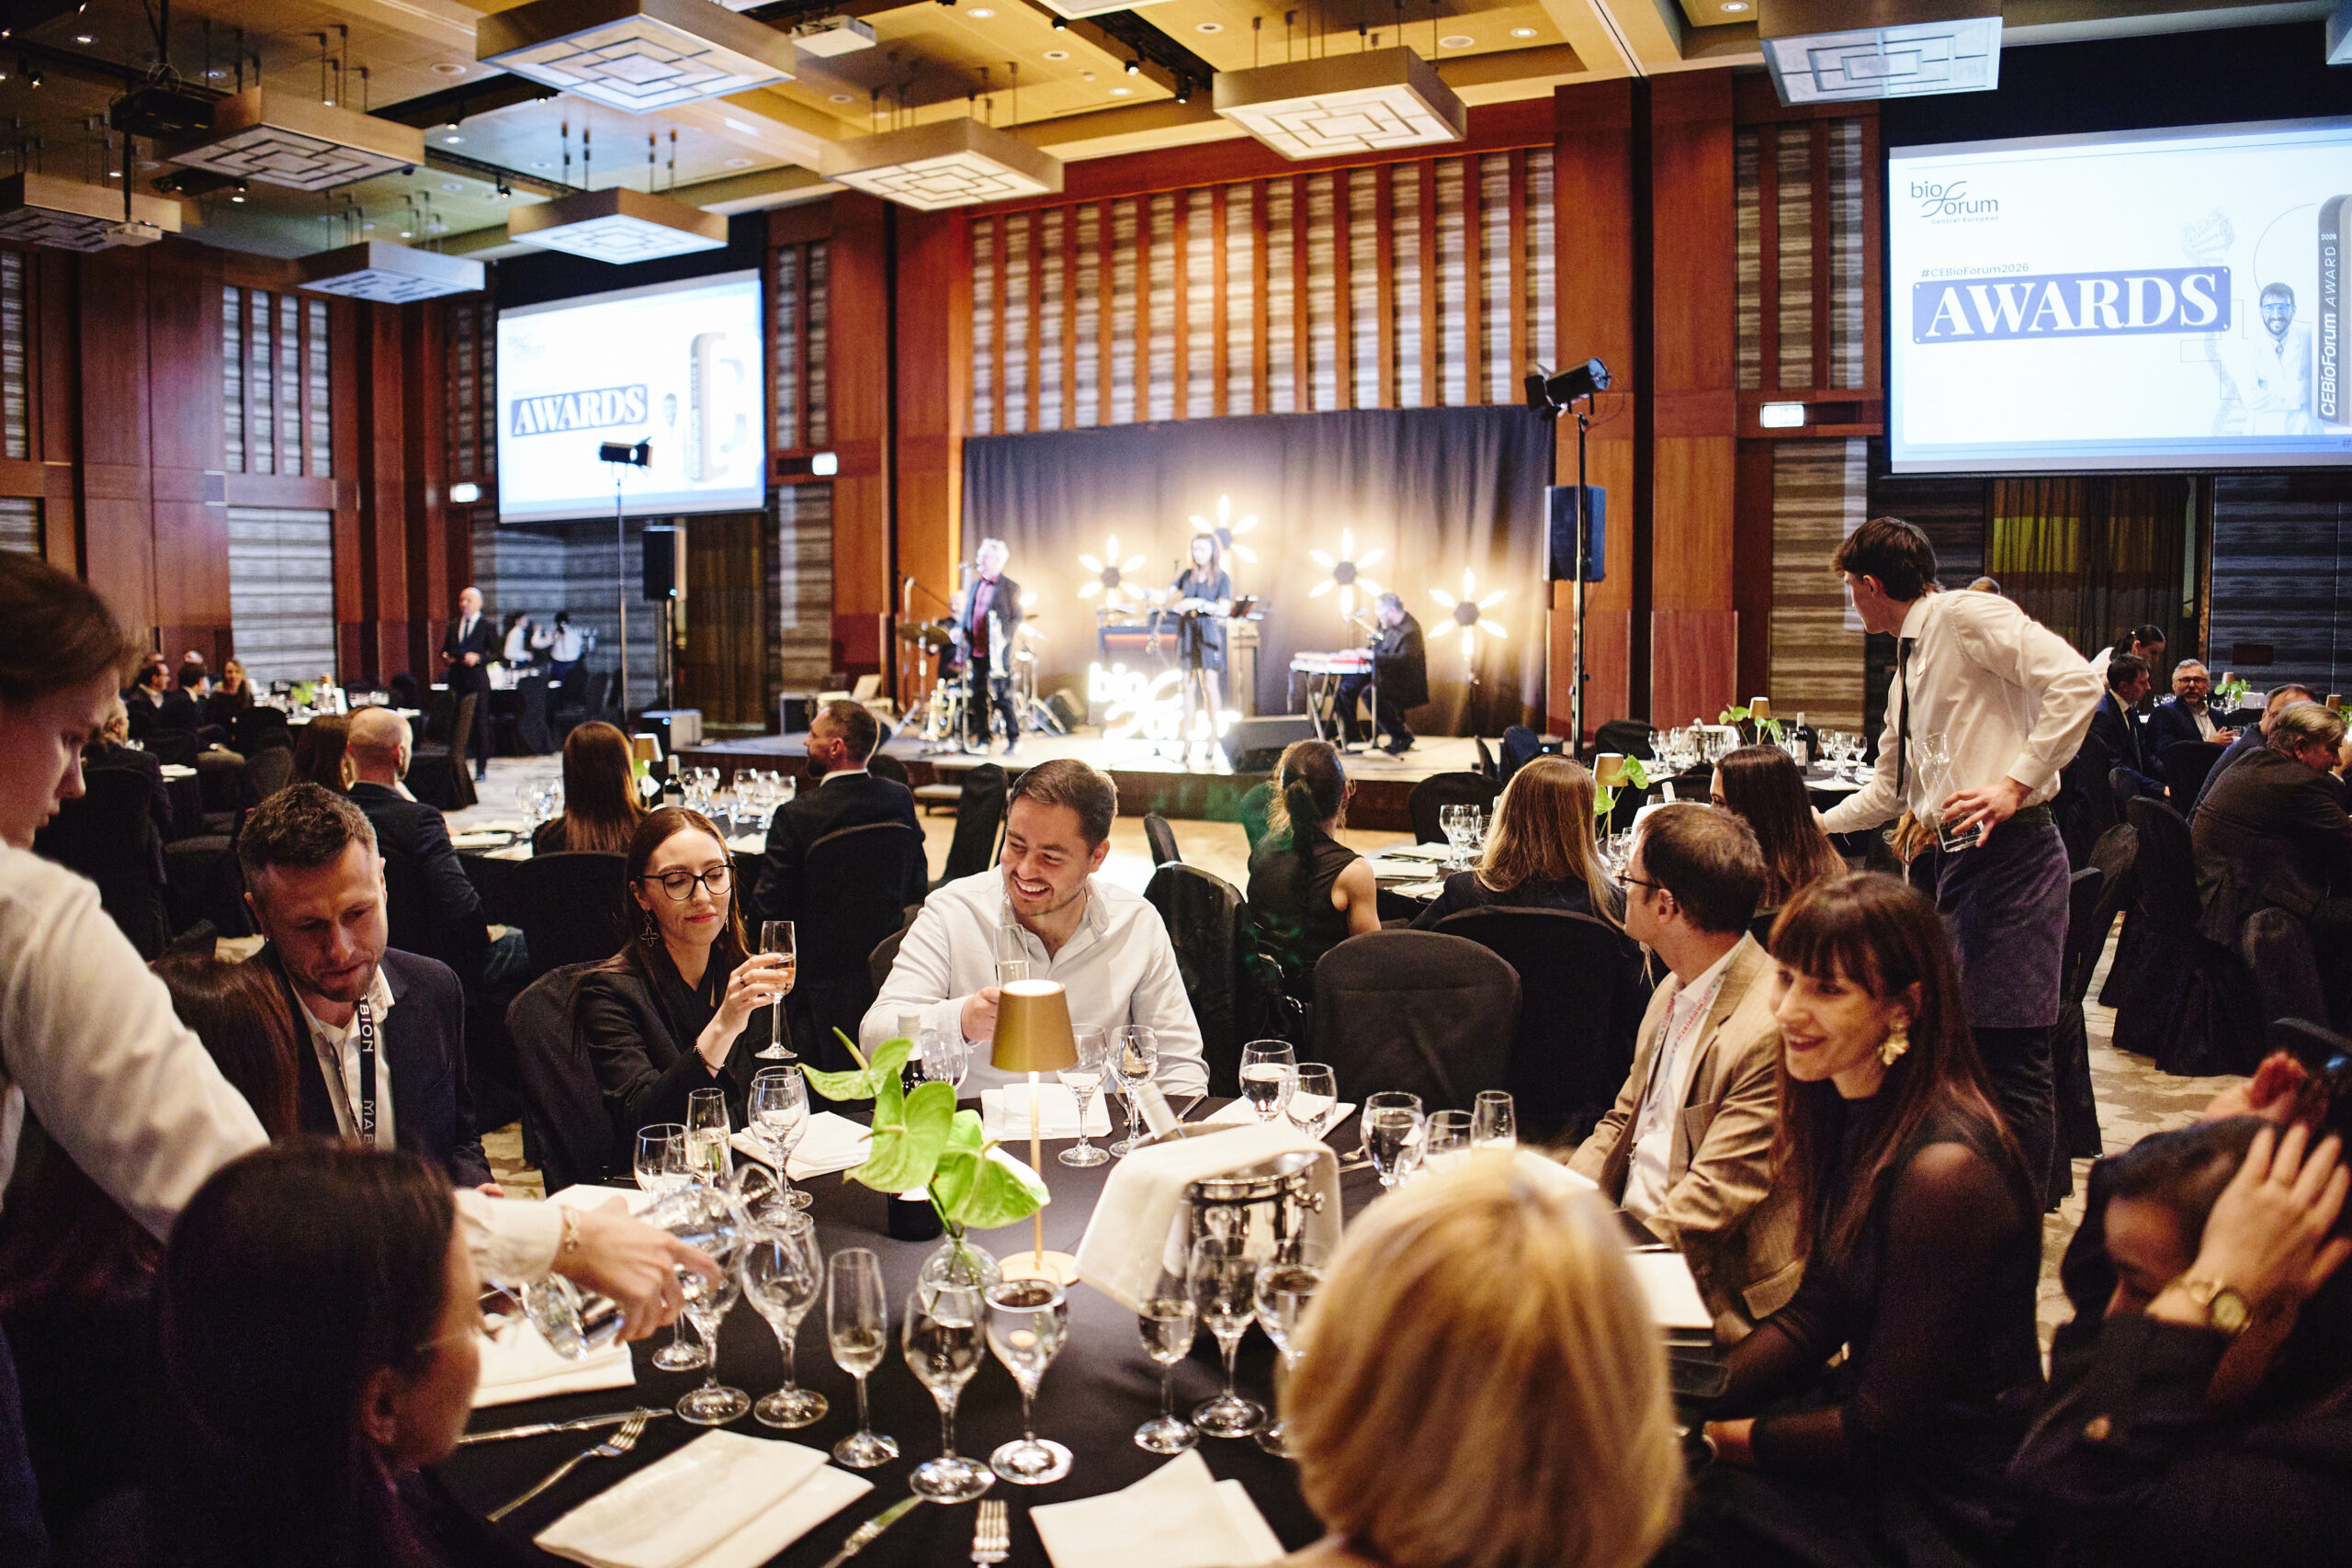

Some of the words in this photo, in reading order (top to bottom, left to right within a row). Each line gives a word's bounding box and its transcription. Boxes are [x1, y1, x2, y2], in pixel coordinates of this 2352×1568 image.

[1911, 180, 1943, 198] bio
[1920, 263, 2030, 277] #CEBioForum2026
[2325, 245, 2338, 309] AWARD
[1925, 274, 2219, 337] AWARDS
[2320, 312, 2337, 417] CEBioForum
[514, 386, 646, 435] AWARDS
